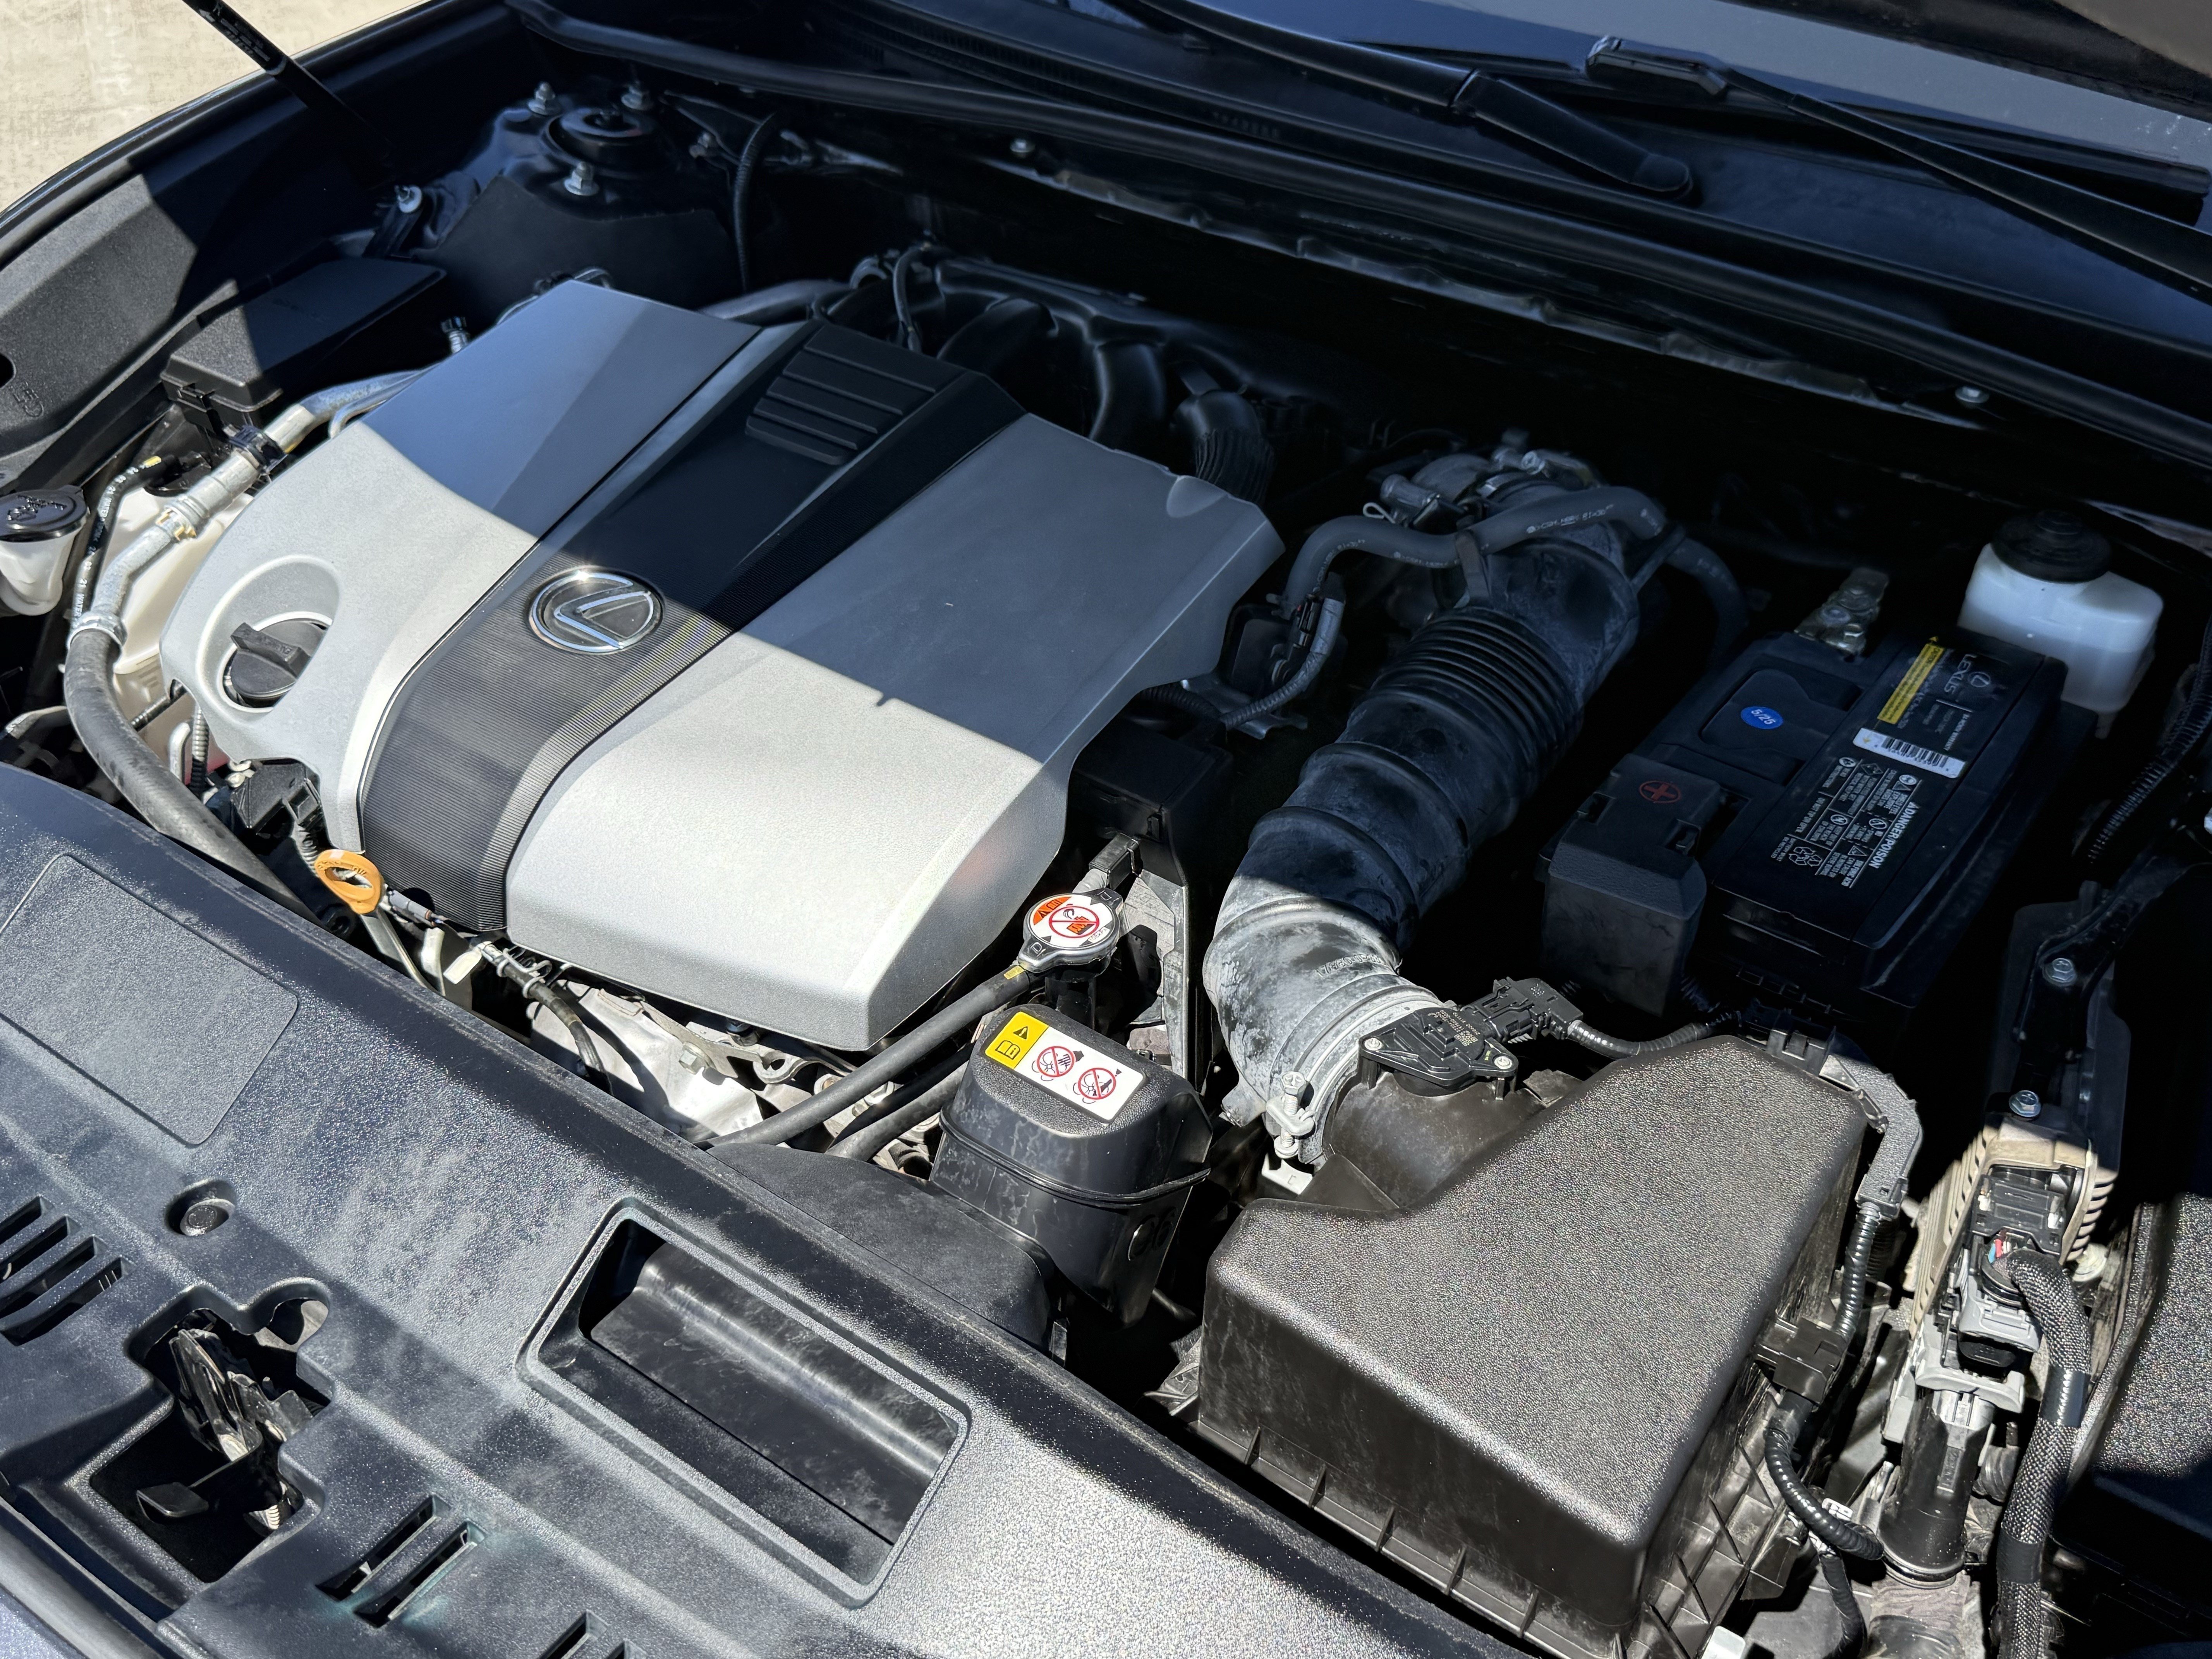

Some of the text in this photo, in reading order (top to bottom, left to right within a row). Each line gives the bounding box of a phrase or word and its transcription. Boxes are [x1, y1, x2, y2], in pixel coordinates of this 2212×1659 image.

[1944, 654, 1977, 694] LEXUS
[1751, 709, 1776, 725] 5/25
[1869, 808, 1915, 868] DANGER/POISON
